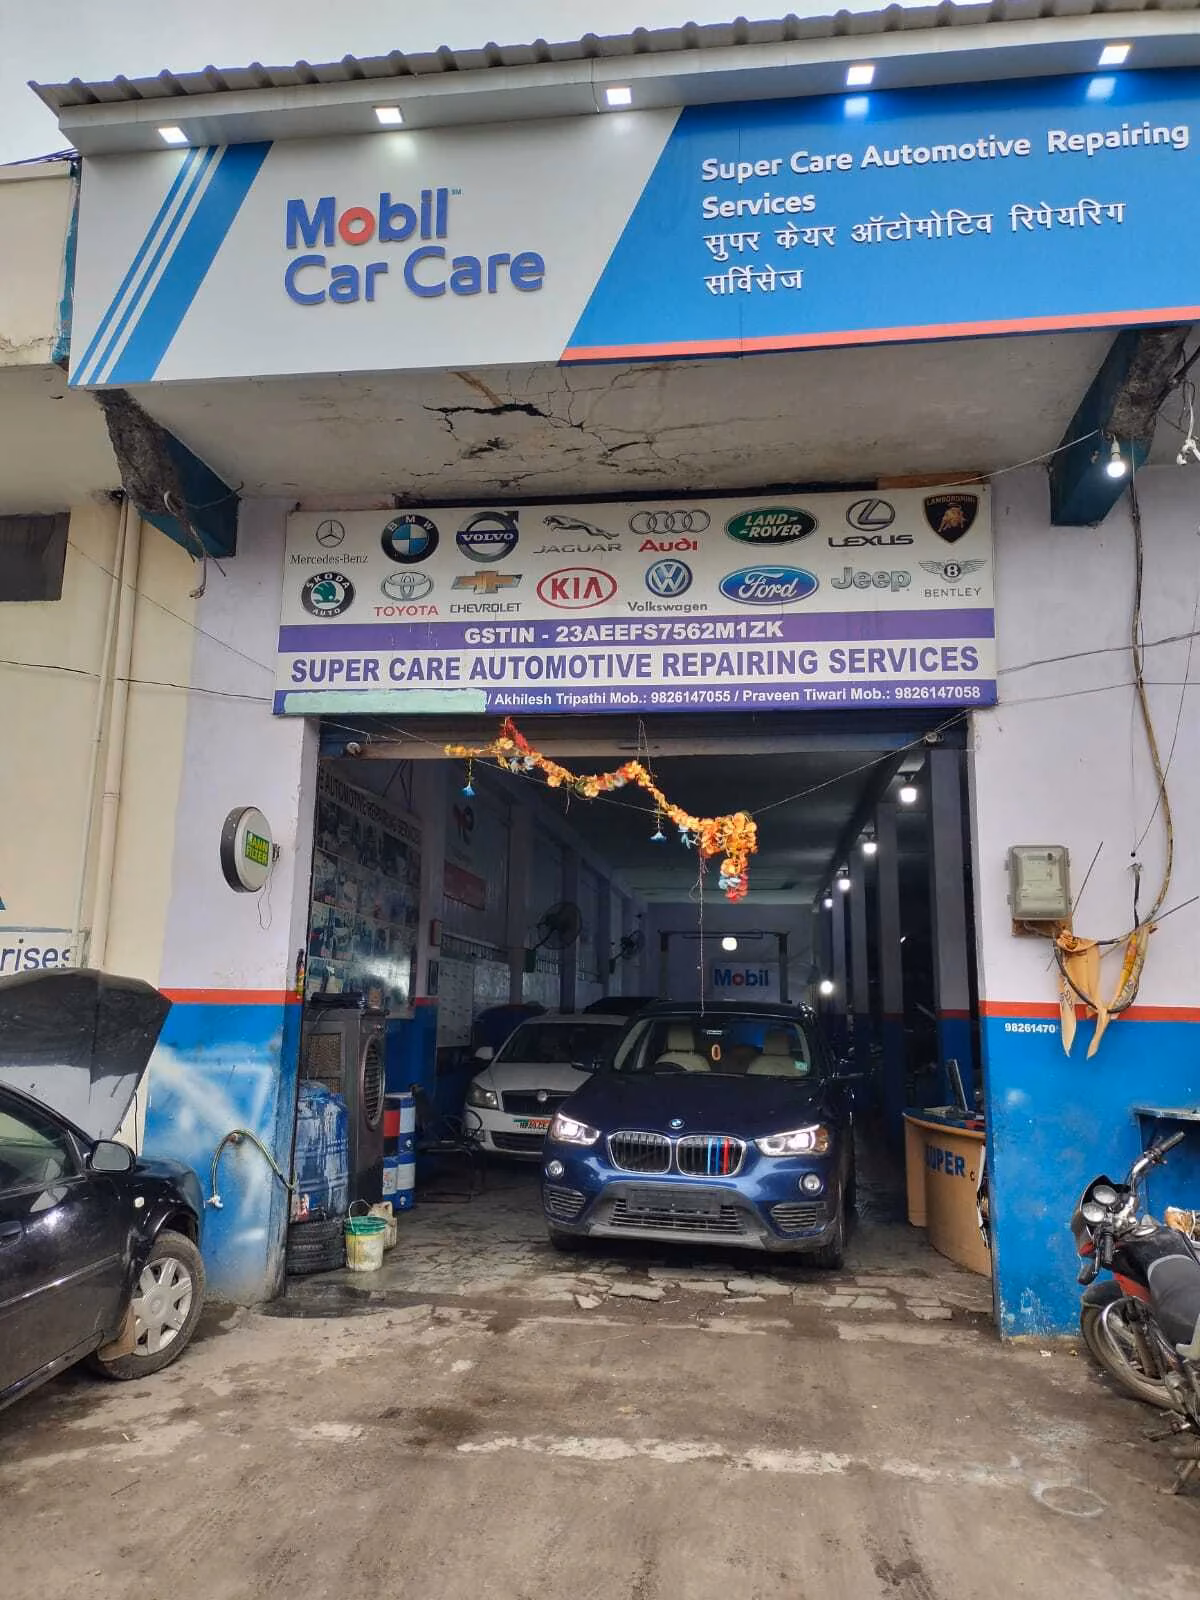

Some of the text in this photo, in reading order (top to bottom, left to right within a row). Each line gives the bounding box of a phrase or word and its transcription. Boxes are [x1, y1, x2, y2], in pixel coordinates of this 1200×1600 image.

[702, 121, 1190, 184] Super Care Automotive Repairing
[702, 192, 817, 219] Services
[285, 187, 449, 249] Mobil
[703, 231, 761, 262] सुपर
[774, 221, 837, 249] केयर
[851, 209, 994, 243] ऑटोमोटिव
[284, 245, 546, 306] Car Care
[703, 264, 804, 295] सर्विसेज
[461, 532, 515, 542] VOLVO
[638, 537, 698, 552] Audi
[828, 534, 914, 548] LEXUS
[533, 543, 623, 554] JAGUAR
[290, 554, 368, 565] Mercedes-Benz
[551, 577, 604, 600] KIA
[738, 571, 799, 599] Ford
[831, 566, 911, 592] Jeep
[924, 587, 982, 598] BENTLEY
[373, 605, 439, 617] TOYOTA
[450, 602, 522, 613] CHEVROLET
[627, 601, 708, 613] Volkswagen
[464, 627, 535, 644] GSTIN
[555, 620, 785, 642] 23AEEFS7562M1ZK
[291, 646, 979, 683] SUPER CARE AUTOMOTIVE REPAIRING SERVICES
[494, 692, 552, 705] Akhilesh
[556, 691, 606, 707] Tripathi
[610, 691, 647, 704] Mob.:
[651, 690, 731, 703] 9826147055
[743, 689, 800, 702] Praveen
[803, 688, 847, 701] Tiwari
[850, 687, 890, 700] Mob.:
[894, 686, 981, 699] 9826147058
[714, 968, 769, 986] Mobil
[1004, 1022, 1058, 1033] 98261470
